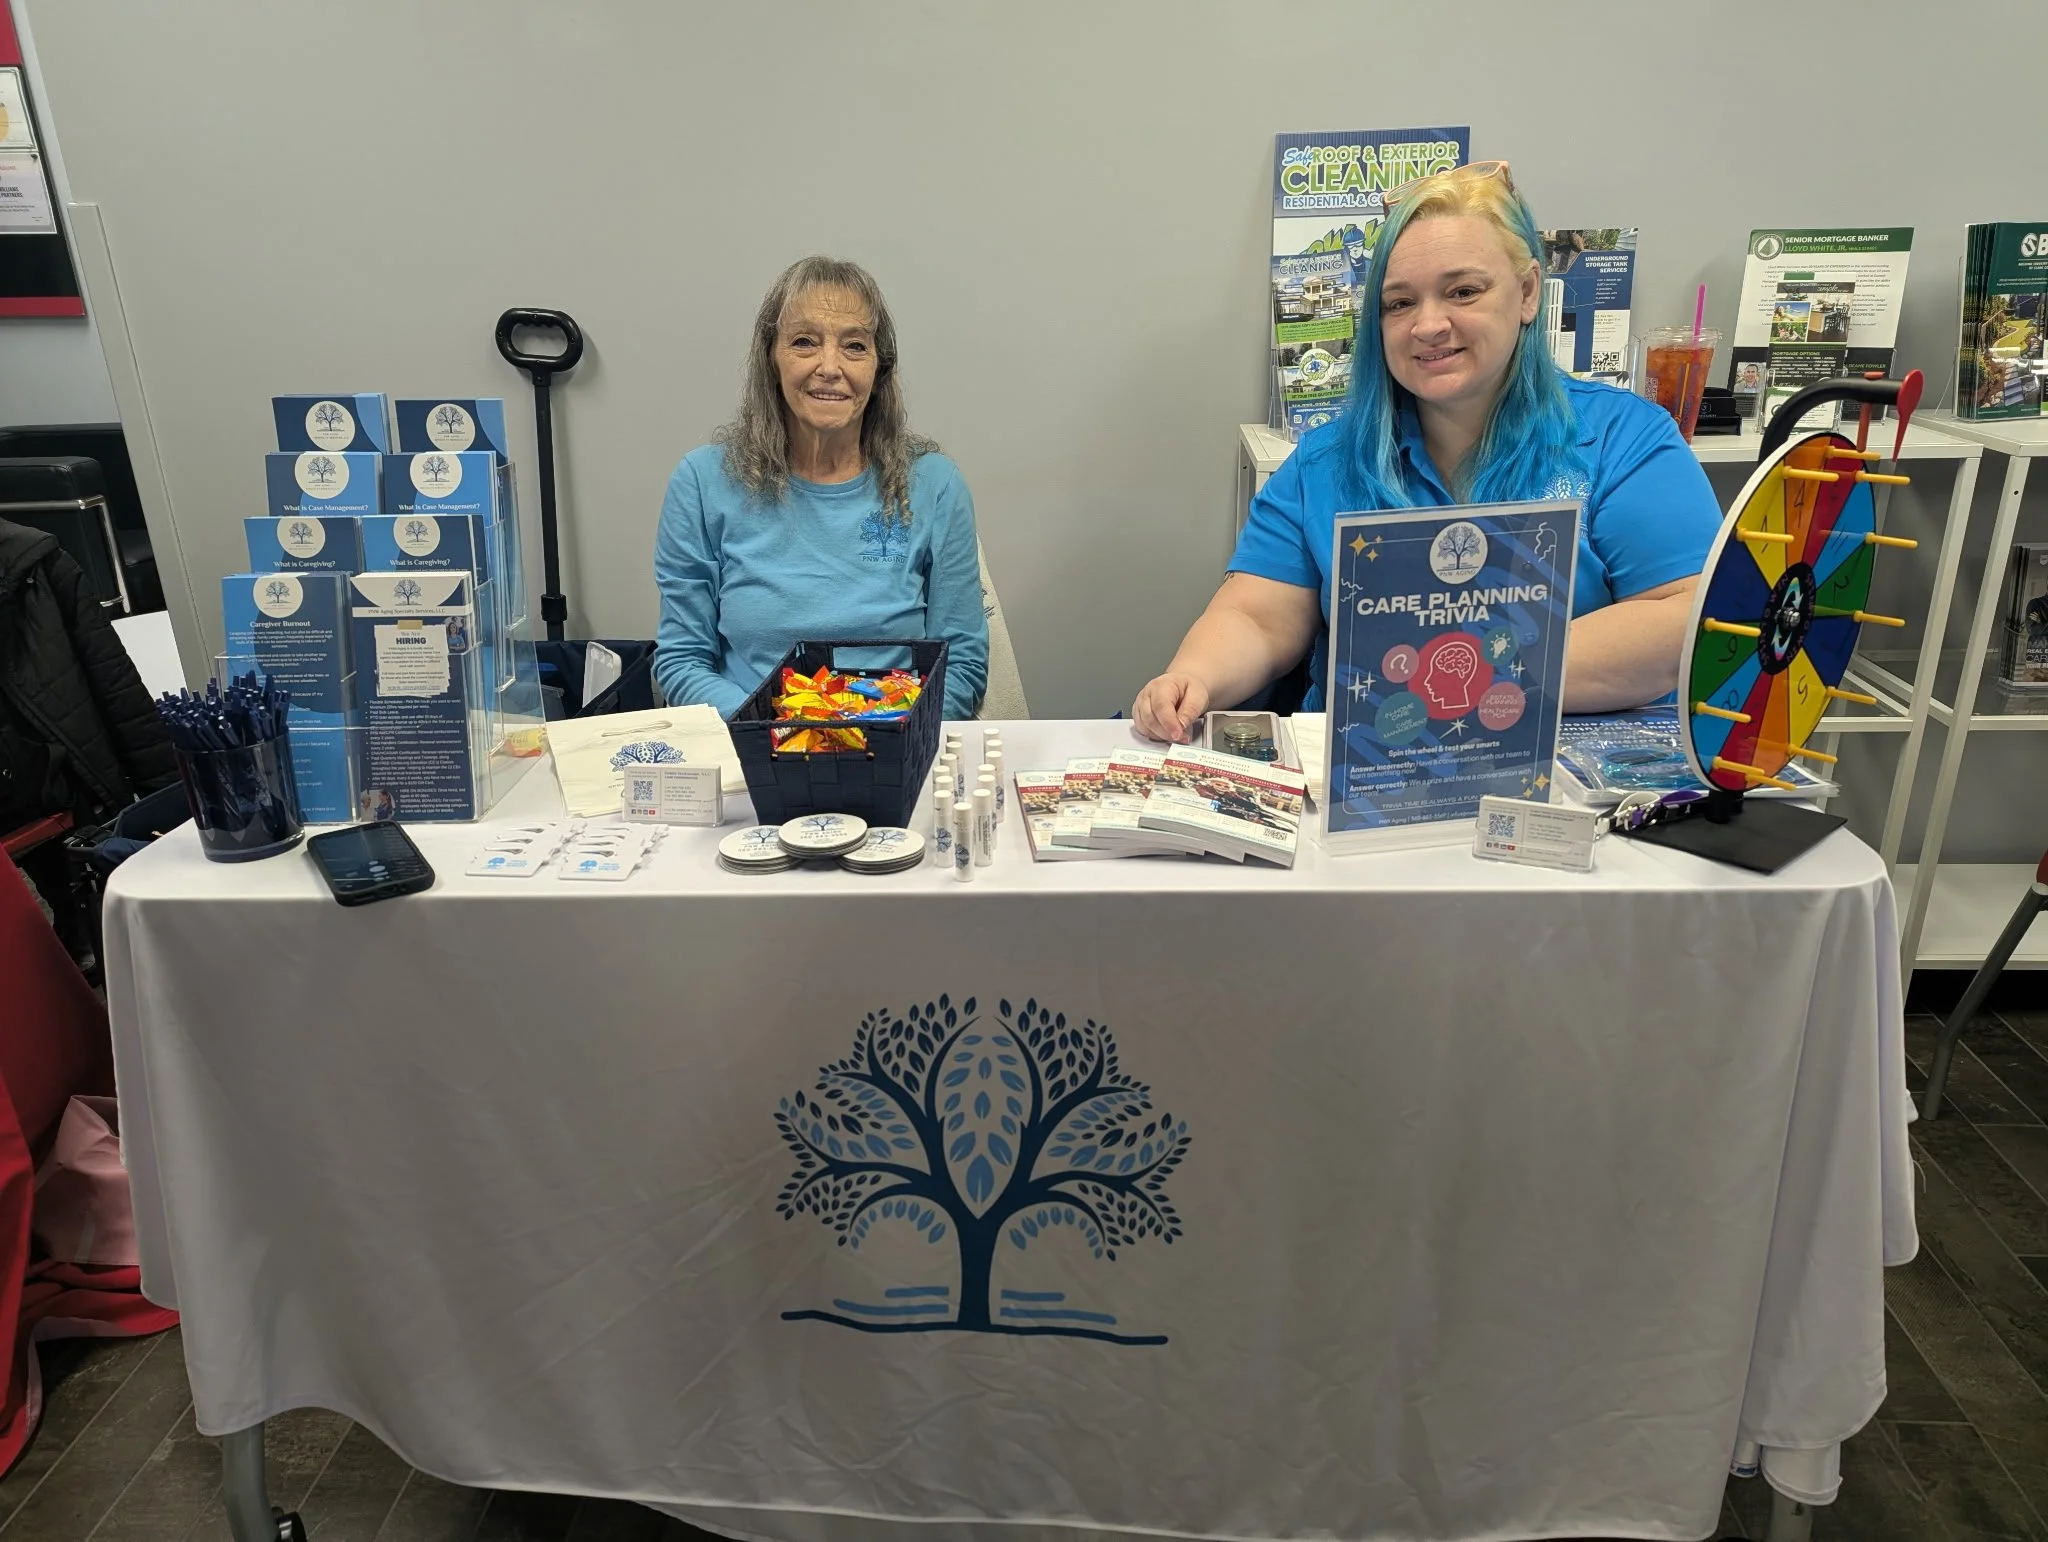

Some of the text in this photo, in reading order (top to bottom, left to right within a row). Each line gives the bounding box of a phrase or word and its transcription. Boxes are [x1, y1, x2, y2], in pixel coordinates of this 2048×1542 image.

[1283, 142, 1459, 165] Safe ROOF & EXTERIOR
[1283, 194, 1366, 209] RESIDENTIAL &
[1814, 235, 1856, 243] MORTGAGE
[1279, 260, 1343, 275] CLEANING
[324, 504, 368, 513] Management?
[398, 503, 414, 511] What
[422, 503, 436, 511] Case
[438, 502, 480, 512] Management?
[299, 560, 336, 569] Caregiving?
[414, 558, 450, 567] Caregiving?
[1357, 584, 1548, 616] CARE PLANNING
[1414, 605, 1490, 627] TRIVIA
[249, 621, 282, 629] Caregiver
[1384, 718, 1428, 739] MANAGEMENT
[1388, 750, 1402, 758] Spin
[1403, 748, 1416, 756] the
[1416, 746, 1438, 755] wheel
[1445, 744, 1459, 752] test
[1459, 743, 1475, 753] your
[1476, 740, 1500, 749] smarts
[1172, 760, 1202, 769] Greater
[1202, 754, 1250, 768] Retirement
[1350, 766, 1376, 774] Answer
[1376, 762, 1415, 772] incorrectly:
[1437, 756, 1480, 766] conversation
[1480, 753, 1495, 761] with
[1350, 784, 1375, 792] Answer
[1376, 780, 1408, 792] correctly:
[1426, 776, 1442, 786] prize
[1456, 773, 1471, 781] have
[1476, 769, 1518, 780] conversation
[1518, 767, 1532, 776] with
[1366, 770, 1401, 780] something
